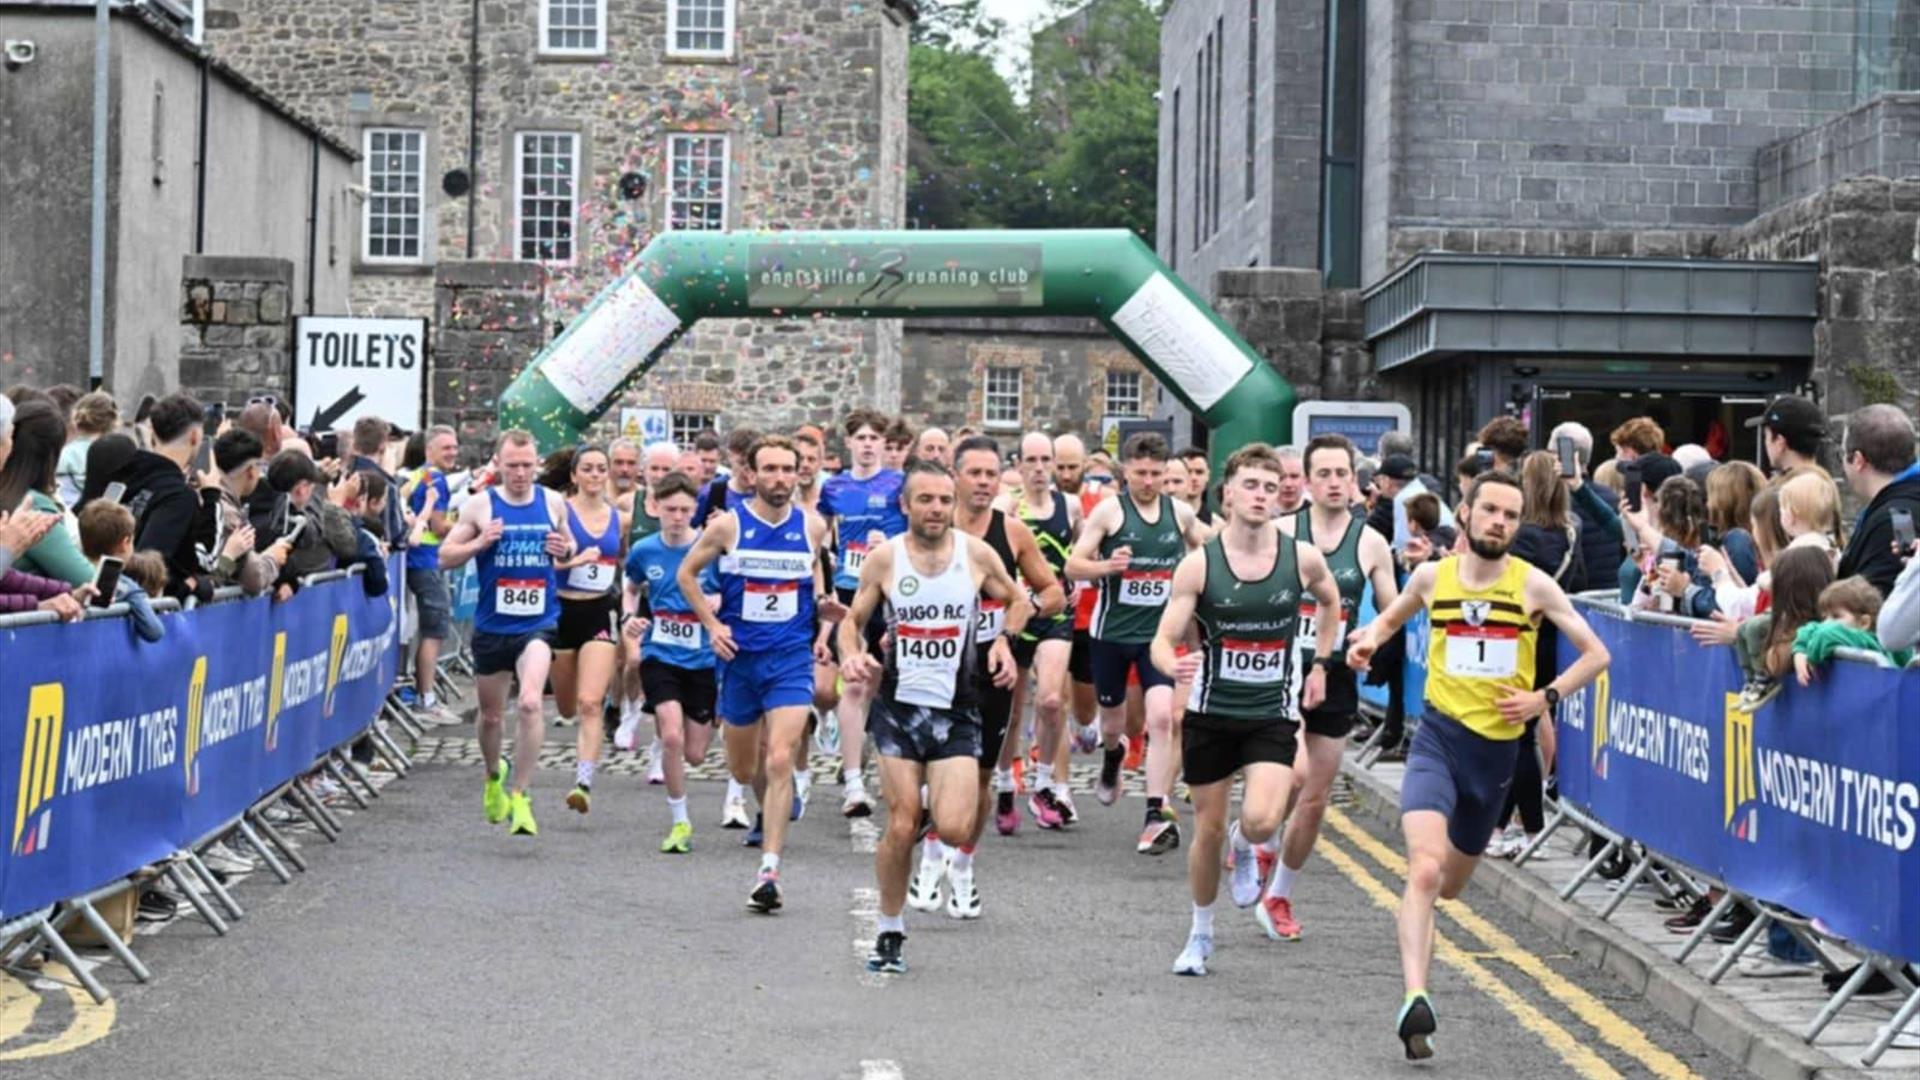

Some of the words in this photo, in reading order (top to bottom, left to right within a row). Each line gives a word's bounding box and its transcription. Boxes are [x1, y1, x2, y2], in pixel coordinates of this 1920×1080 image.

[907, 266, 979, 286] running
[989, 265, 1029, 284] club
[306, 331, 416, 369] TOILETS
[587, 564, 598, 580] 3
[503, 588, 540, 606] 846
[1128, 581, 1164, 596] 865
[765, 594, 778, 611] 2
[660, 620, 693, 638] 580
[900, 638, 956, 660] 1400
[1477, 640, 1485, 663] 1
[1226, 650, 1281, 671] 1064
[200, 683, 242, 749] MODERN
[61, 717, 136, 795] MODERN
[137, 705, 178, 774] TYRES
[1608, 698, 1667, 766] MODERN
[1668, 715, 1710, 784] TYRES
[1757, 746, 1837, 828] MODERN
[1840, 767, 1920, 852] TYRES
